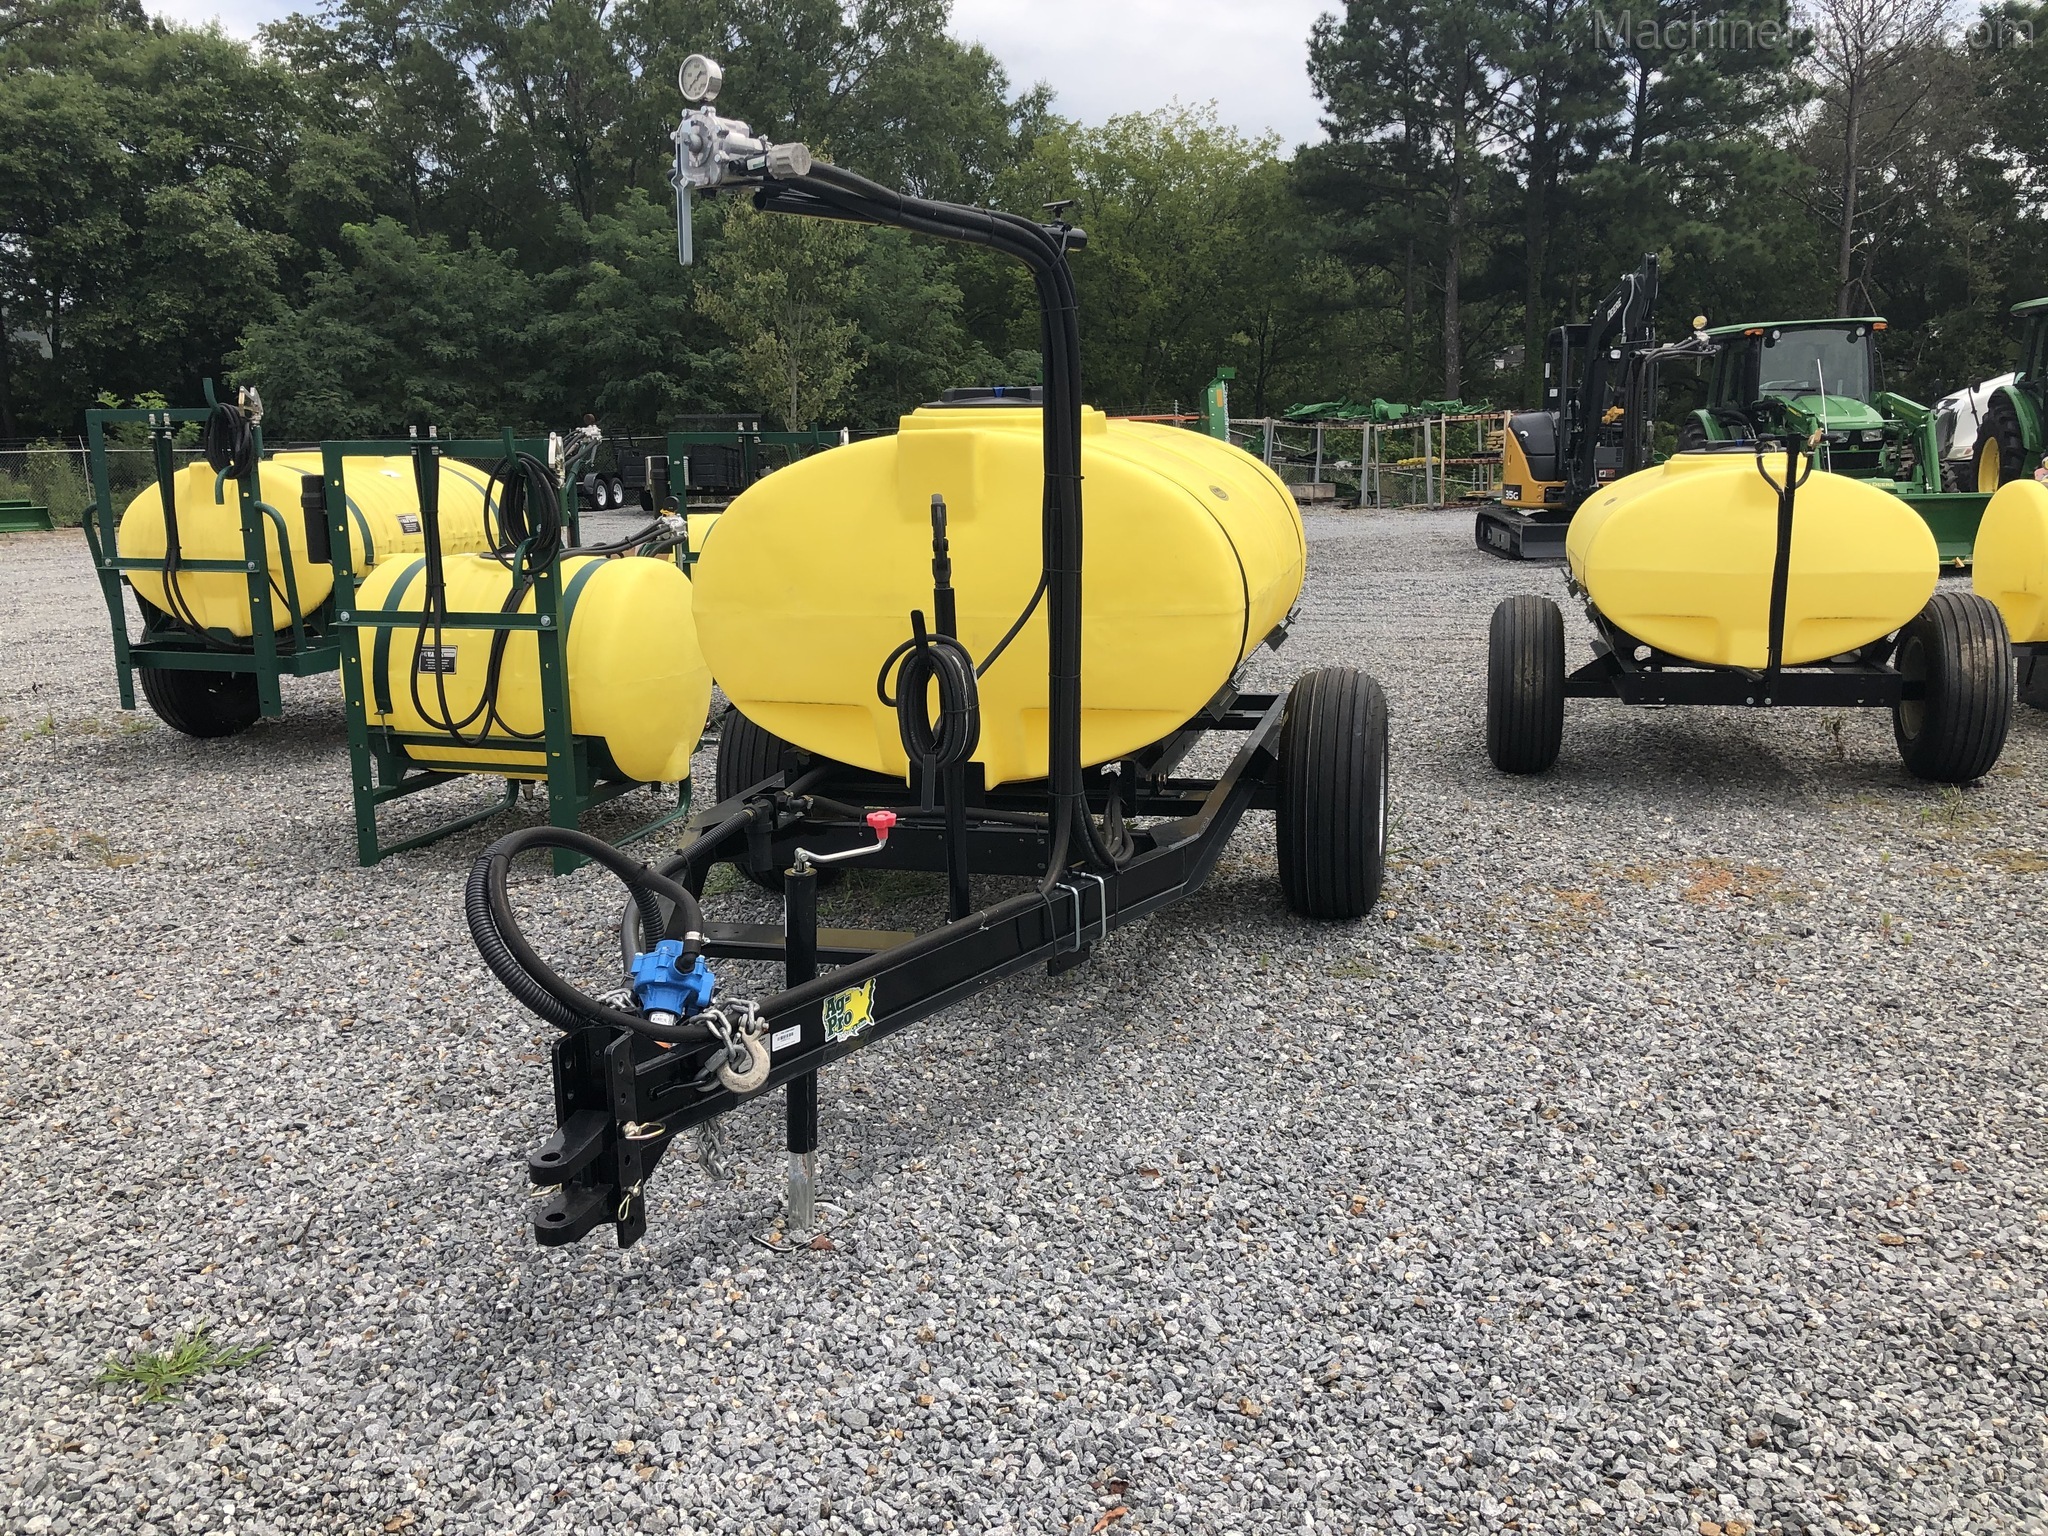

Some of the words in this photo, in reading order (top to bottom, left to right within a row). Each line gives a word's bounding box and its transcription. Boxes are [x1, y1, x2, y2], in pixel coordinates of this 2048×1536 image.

[1607, 296, 1622, 322] DEERE
[1505, 489, 1519, 501] 35G
[825, 995, 851, 1020] Ag-
[826, 1011, 853, 1038] Pro
